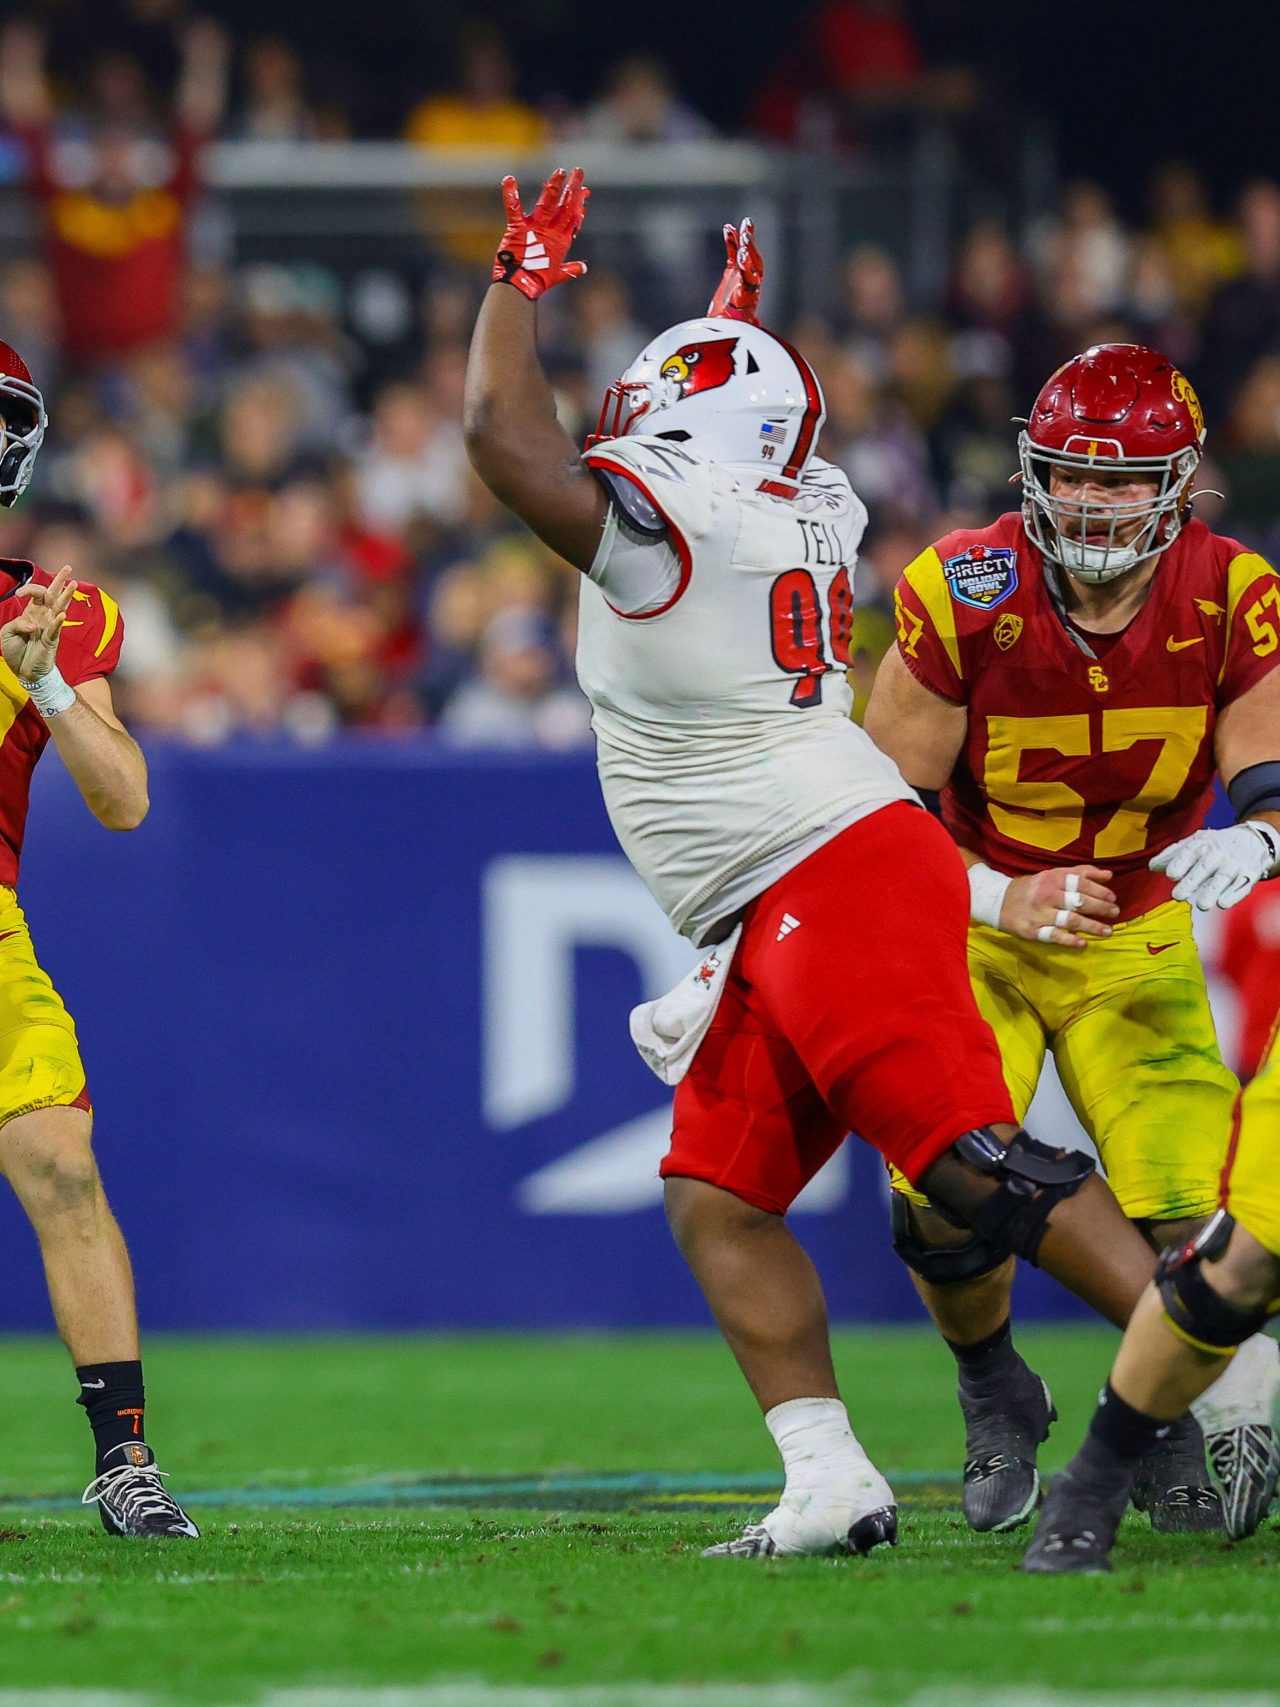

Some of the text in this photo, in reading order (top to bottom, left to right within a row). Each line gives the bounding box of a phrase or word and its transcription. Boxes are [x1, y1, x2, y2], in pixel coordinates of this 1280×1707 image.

[761, 444, 775, 460] 99
[796, 518, 846, 565] TELL
[944, 556, 1015, 579] DIRECTV
[958, 572, 1008, 589] HOLIDAY
[967, 581, 1003, 595] BOWL
[984, 705, 1208, 859] 57
